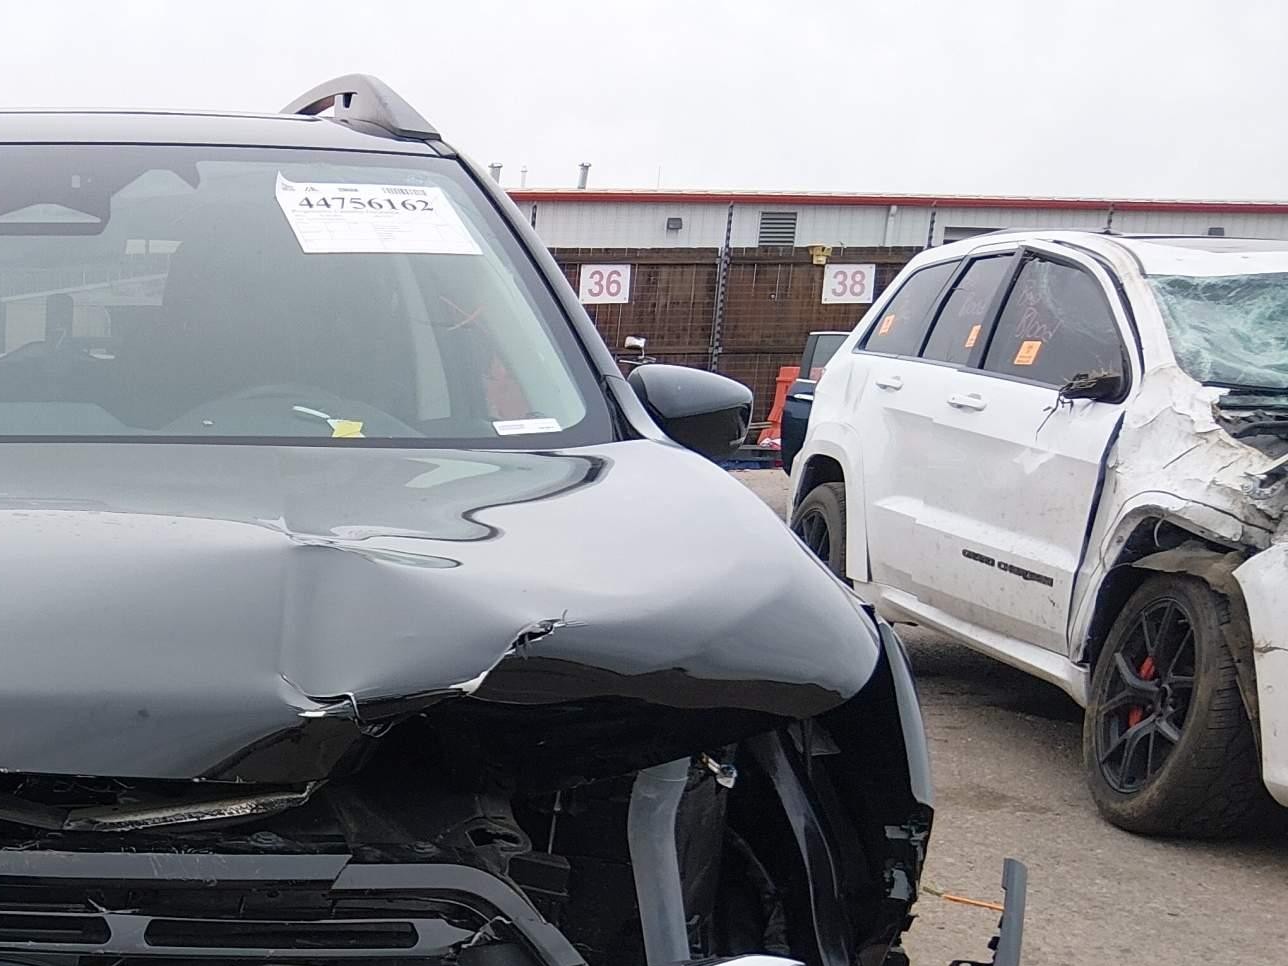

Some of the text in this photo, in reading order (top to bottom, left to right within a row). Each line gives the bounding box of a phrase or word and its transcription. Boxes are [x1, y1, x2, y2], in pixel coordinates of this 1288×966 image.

[298, 196, 433, 212] 44756162
[587, 270, 622, 297] 36
[831, 270, 866, 297] 38
